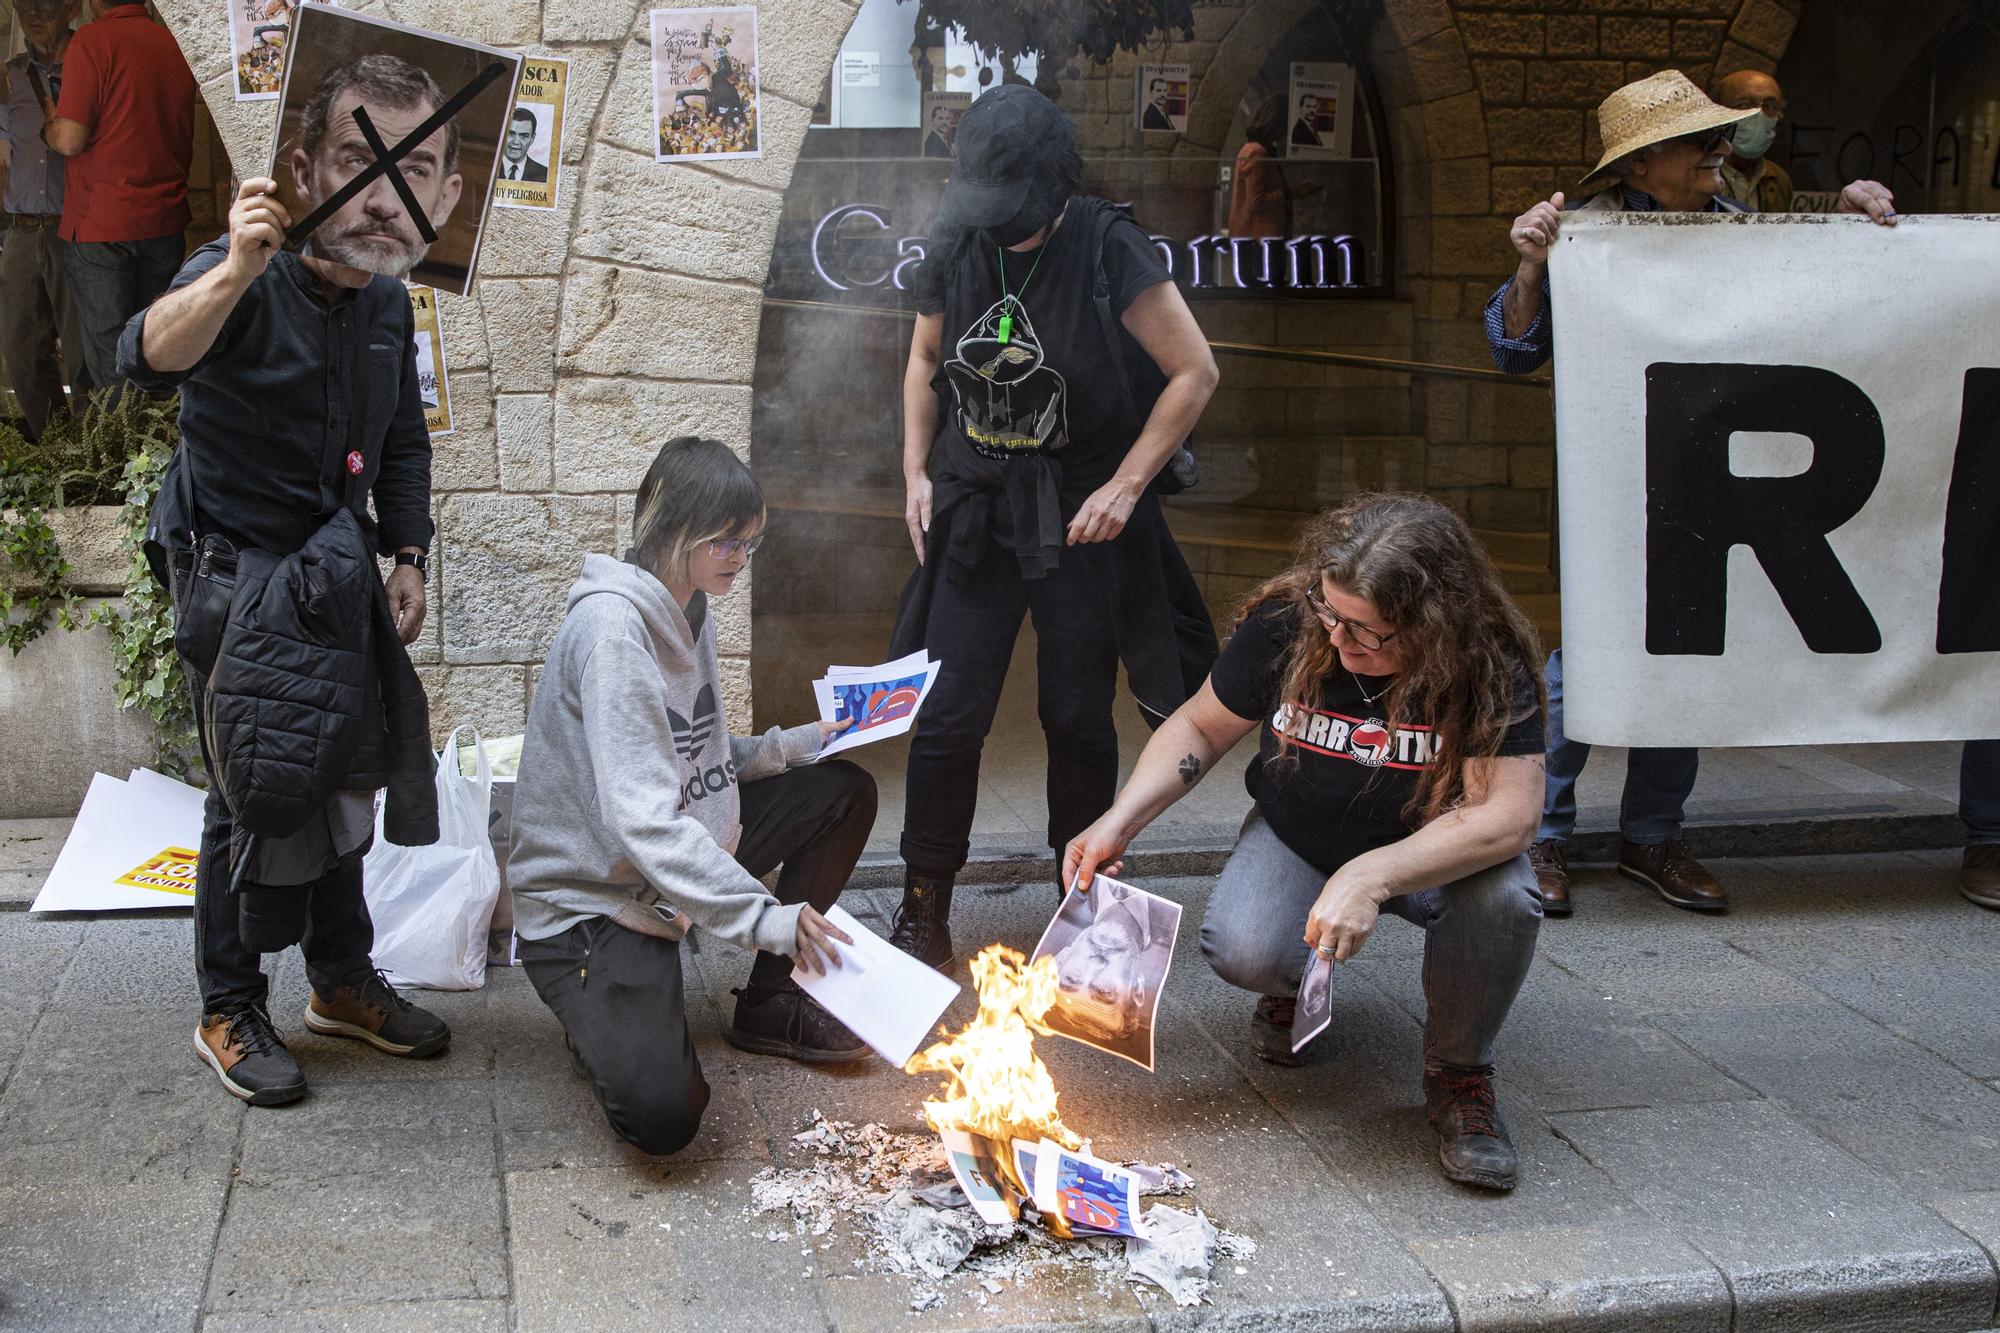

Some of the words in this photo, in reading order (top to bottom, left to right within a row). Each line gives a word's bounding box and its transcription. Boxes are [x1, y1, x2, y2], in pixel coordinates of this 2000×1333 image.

[525, 66, 558, 82] SCA
[519, 84, 543, 97] ADOR
[1790, 122, 1960, 189] FORA
[496, 187, 507, 199] UY
[507, 187, 548, 202] PELIGROSA
[811, 203, 926, 291] Ca
[1149, 234, 1369, 290] orum
[132, 873, 197, 891] ALUNYA
